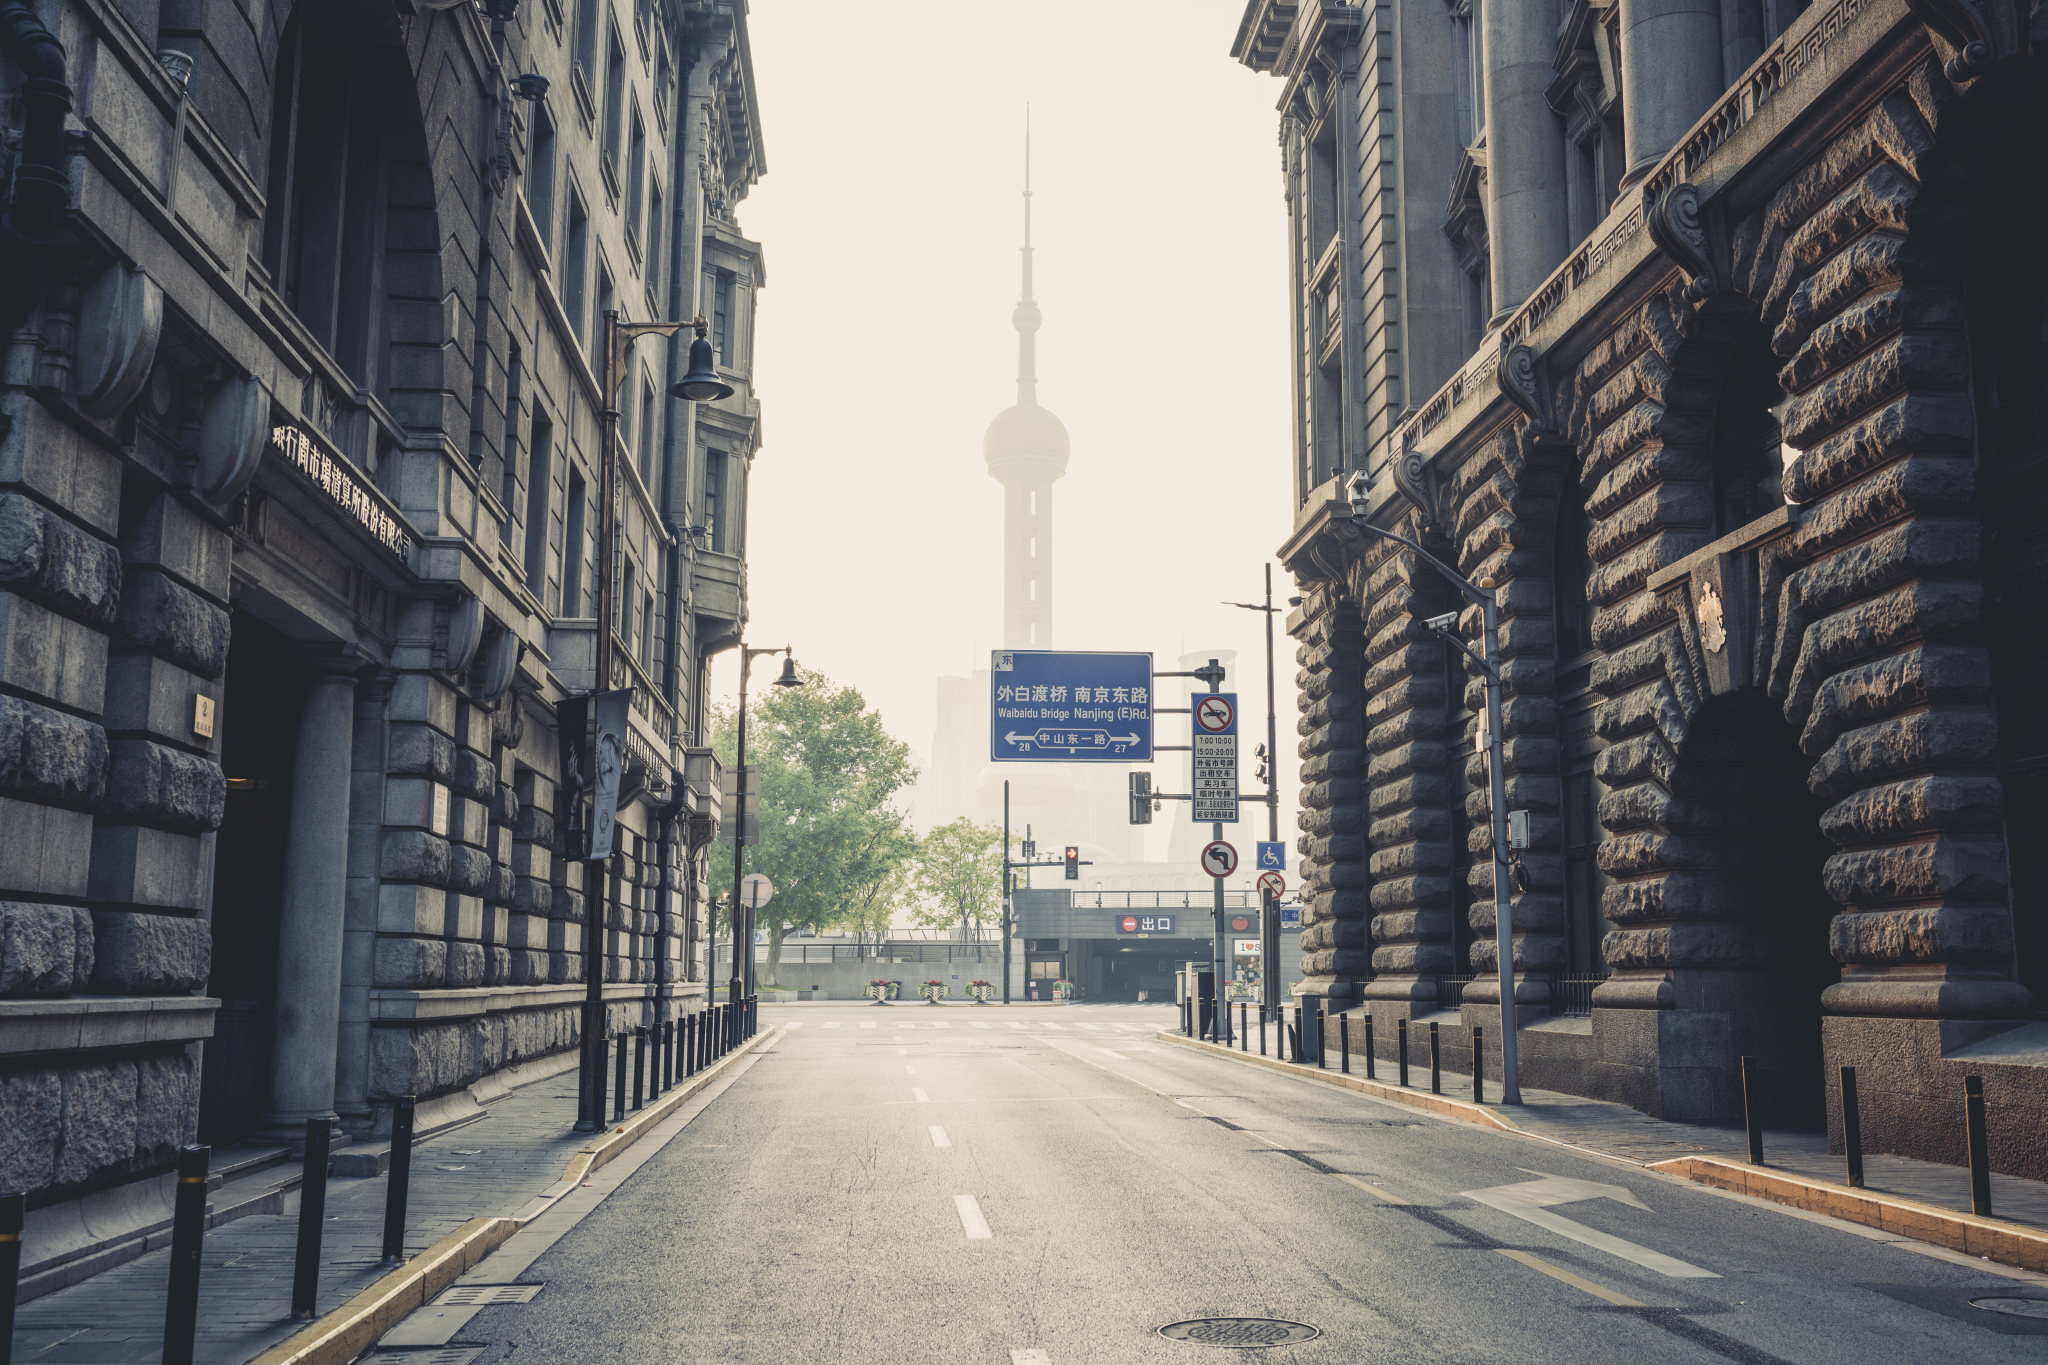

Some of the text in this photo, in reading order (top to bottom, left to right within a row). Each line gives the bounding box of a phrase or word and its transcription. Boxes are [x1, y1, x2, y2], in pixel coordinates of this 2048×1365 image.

[1002, 654, 1013, 665] 东
[997, 684, 1148, 704] 外白渡桥 南京东路
[998, 707, 1038, 718] Waibaidu
[1041, 708, 1070, 721] Bridge
[1074, 707, 1114, 722] Nanjing
[1039, 732, 1106, 745] 中山东一路
[1018, 743, 1031, 752] 28
[1115, 744, 1127, 753] 27
[1197, 759, 1234, 767] 外省市号牌
[1204, 780, 1228, 788] 实习车
[1199, 790, 1231, 798] 临时号牌
[1141, 917, 1171, 931] 出口
[1241, 943, 1245, 951] I
